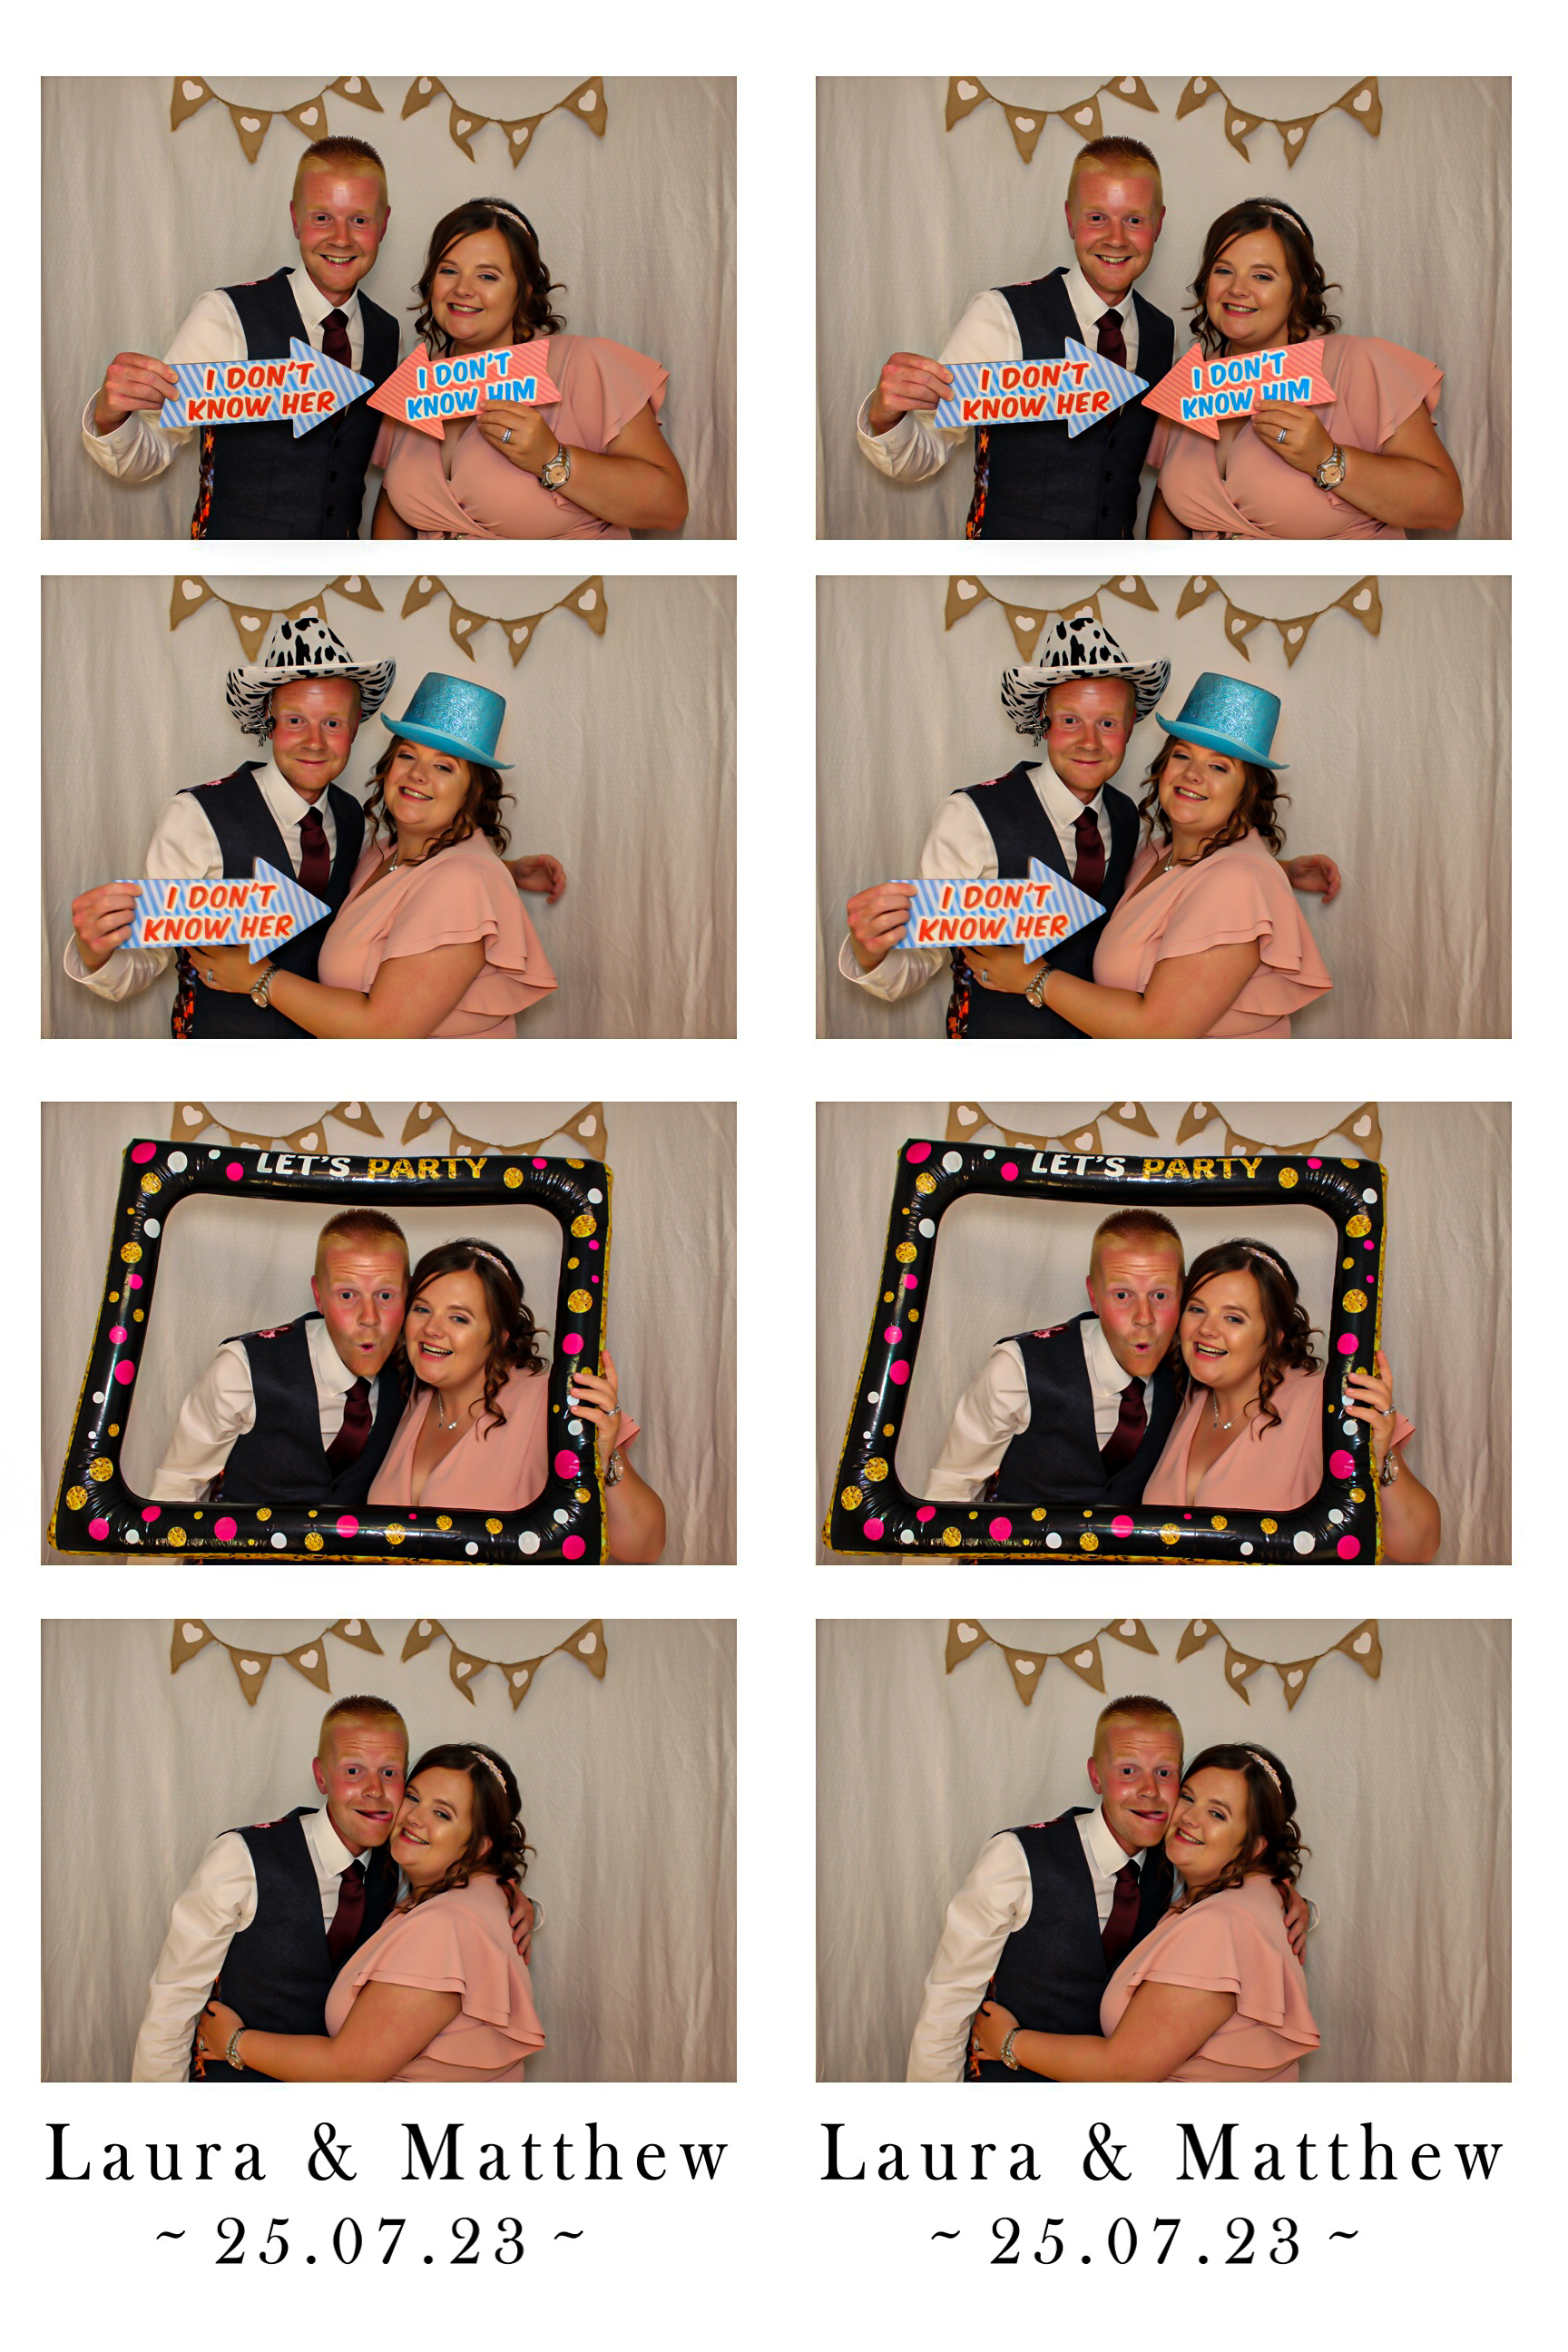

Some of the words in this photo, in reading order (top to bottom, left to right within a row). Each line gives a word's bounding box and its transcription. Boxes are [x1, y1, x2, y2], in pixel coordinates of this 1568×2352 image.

[206, 369, 214, 391] I
[226, 363, 314, 388] DON'T
[418, 368, 426, 388] I
[435, 351, 511, 386] DON'T
[981, 369, 989, 391] I
[1001, 363, 1089, 388] DON'T
[1193, 368, 1200, 388] I
[1210, 351, 1286, 386] DON'T
[188, 395, 271, 421] KNOW
[282, 391, 336, 415] HER
[407, 388, 478, 419] KNOW
[487, 377, 535, 402] HIM
[963, 395, 1046, 421] KNOW
[1057, 391, 1111, 415] HER
[1182, 388, 1253, 419] KNOW
[1262, 377, 1310, 402] HIM
[167, 887, 178, 909] I
[189, 883, 276, 908] DON'T
[942, 887, 953, 909] I
[964, 883, 1051, 908] DON'T
[143, 917, 231, 942] KNOW
[240, 915, 293, 938] HER
[918, 917, 1006, 942] KNOW
[1015, 915, 1068, 938] HER
[256, 1152, 351, 1177] LET'S
[368, 1157, 487, 1180] PARTY
[1031, 1152, 1126, 1177] LET'S
[1142, 1157, 1262, 1180] PARTY
